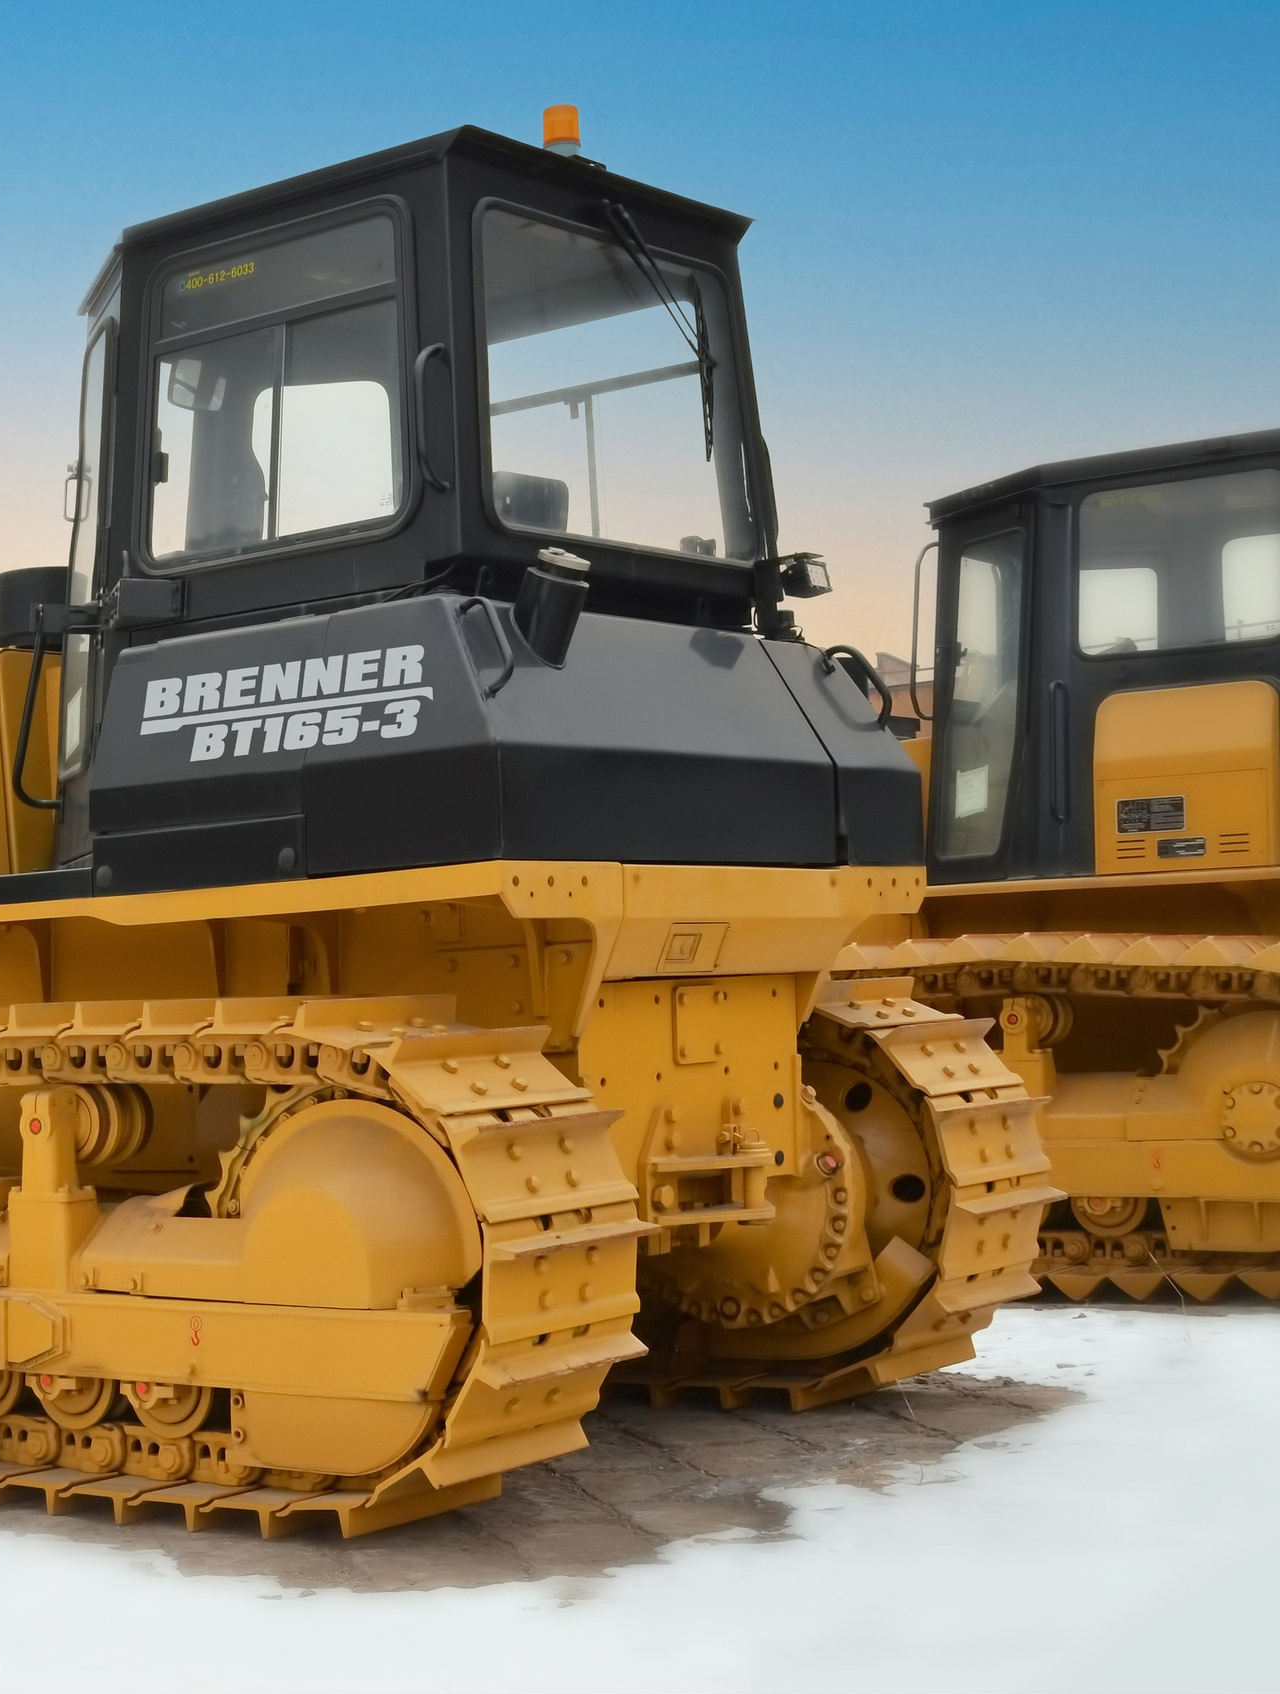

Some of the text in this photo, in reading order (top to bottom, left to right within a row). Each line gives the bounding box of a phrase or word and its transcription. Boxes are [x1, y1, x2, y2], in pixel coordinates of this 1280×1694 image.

[186, 262, 254, 290] 400-612-6033
[143, 645, 425, 718] BRENNER
[190, 700, 421, 762] BT165-3
